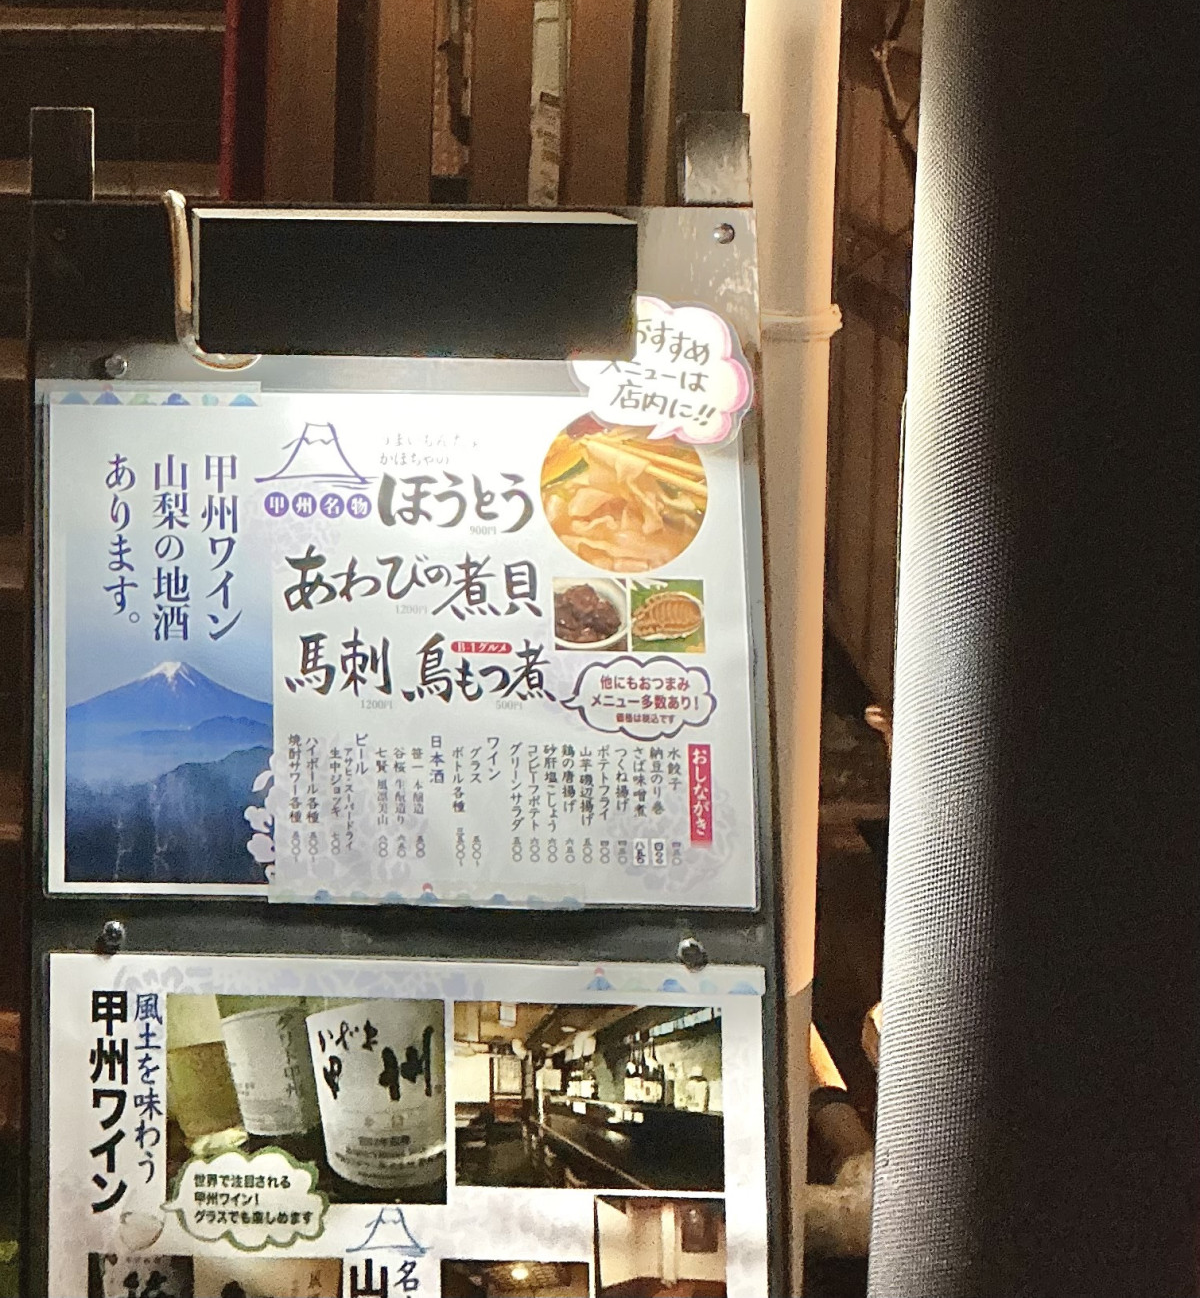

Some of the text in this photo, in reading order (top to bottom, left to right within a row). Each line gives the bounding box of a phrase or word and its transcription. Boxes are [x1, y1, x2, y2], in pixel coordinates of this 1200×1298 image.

[265, 492, 372, 519] 甲州名物
[377, 470, 534, 533] ほうとう
[103, 453, 141, 624] あります。
[152, 454, 191, 641] 山梨の地酒
[201, 453, 243, 641] 甲州ワイン
[284, 544, 542, 621] あわびの煮貝
[284, 627, 557, 703] 馬刺 鳥もつ煮
[600, 675, 690, 691] 他にもおつまみ
[355, 733, 368, 775] ビール
[430, 735, 445, 783] 日本酒
[470, 746, 482, 783] グラス
[487, 737, 500, 781] ワイン
[510, 742, 525, 831] グリーンサラダ
[597, 745, 611, 821] ポテトフライ
[691, 748, 711, 836] おしながき
[89, 990, 128, 1213] 甲州ワイン
[133, 993, 162, 1184] 風土を味わう
[194, 1173, 291, 1189] 世界で注目される
[194, 1210, 313, 1225] グラスでも楽しめます
[394, 1260, 420, 1298] 名
